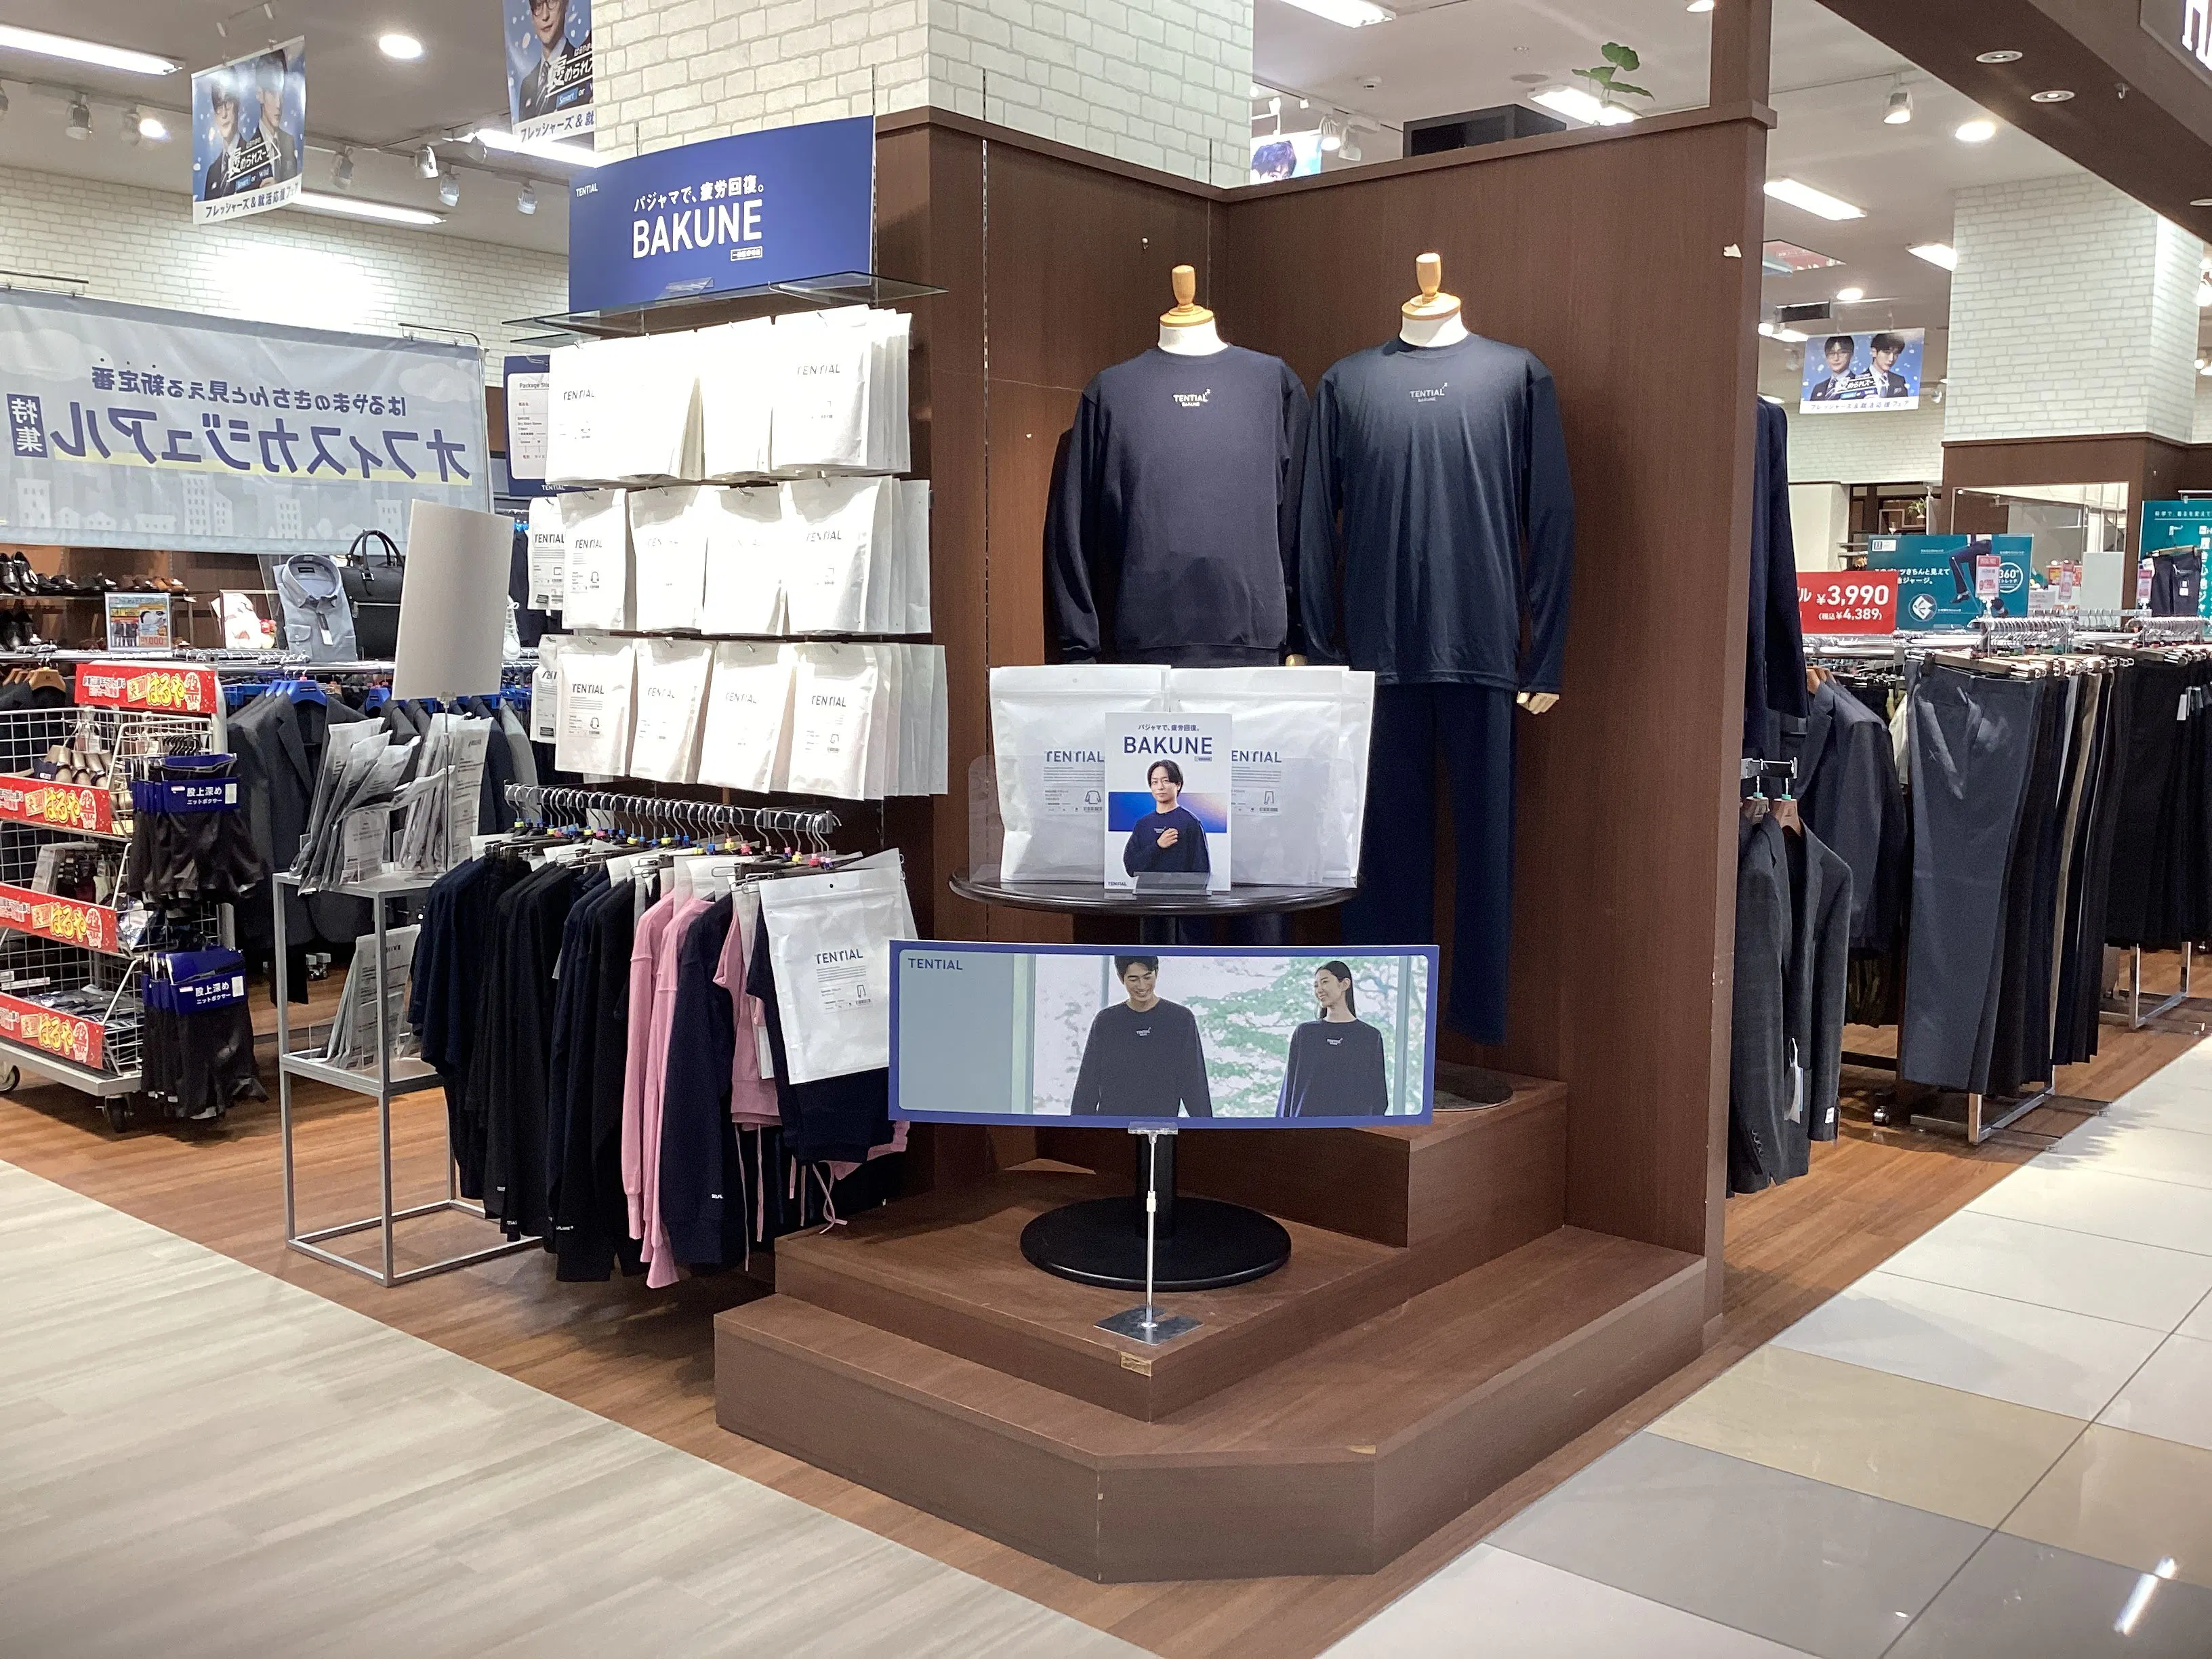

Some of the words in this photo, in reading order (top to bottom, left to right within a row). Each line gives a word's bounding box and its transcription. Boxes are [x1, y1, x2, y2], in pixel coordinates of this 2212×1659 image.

[576, 183, 598, 197] TENTIAL
[634, 174, 764, 213] パジャマで、疲労回復。
[632, 199, 763, 259] BAKUNE
[1173, 393, 1208, 402] TENTIAL
[1410, 388, 1446, 398] TENTIAL
[535, 533, 565, 544] TENTIAL
[1816, 584, 1889, 607] ¥3,990
[571, 683, 605, 695] TENTIAL
[811, 695, 846, 708] TENTIAL
[1124, 736, 1212, 754] BAKUNE
[1045, 750, 1104, 762] TENTIAL
[1231, 750, 1282, 763] ENTIAL
[815, 948, 864, 964] TENTIAL
[907, 958, 964, 970] TENTIAL
